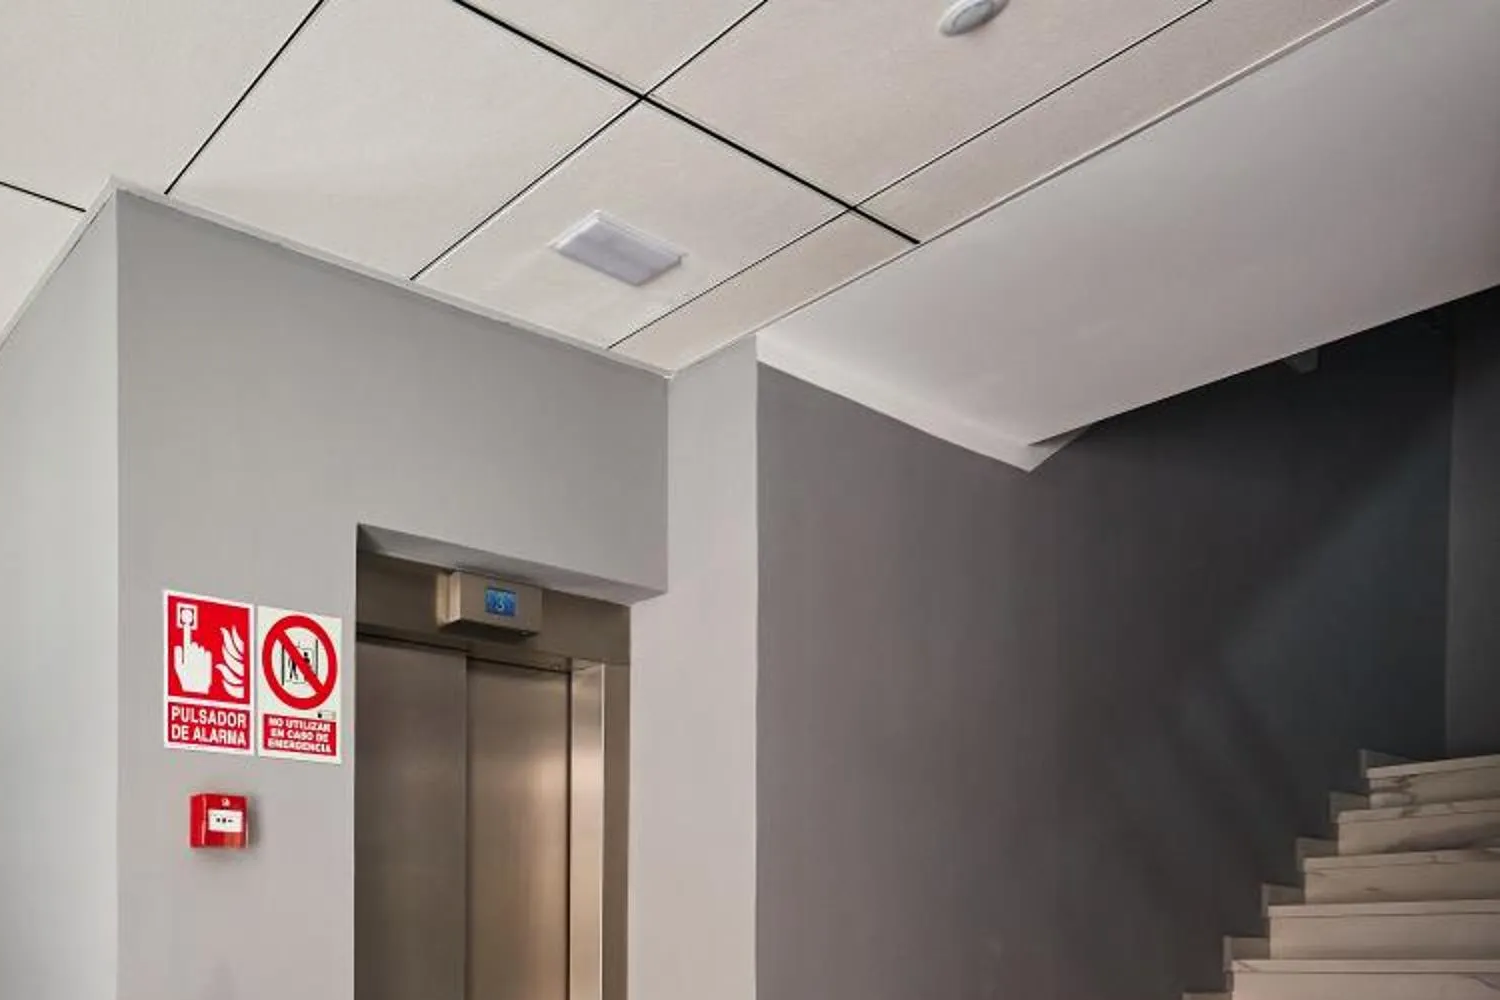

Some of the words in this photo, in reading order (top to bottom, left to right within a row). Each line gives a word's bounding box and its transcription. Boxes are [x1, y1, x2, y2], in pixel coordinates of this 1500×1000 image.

[171, 705, 247, 730] PULSADOR
[268, 717, 284, 727] NO
[285, 718, 331, 733] UTILIZAR
[171, 724, 189, 741] DE
[192, 726, 247, 747] ALARMA
[270, 727, 285, 738] EN
[286, 729, 314, 741] CASO
[315, 732, 330, 743] DE
